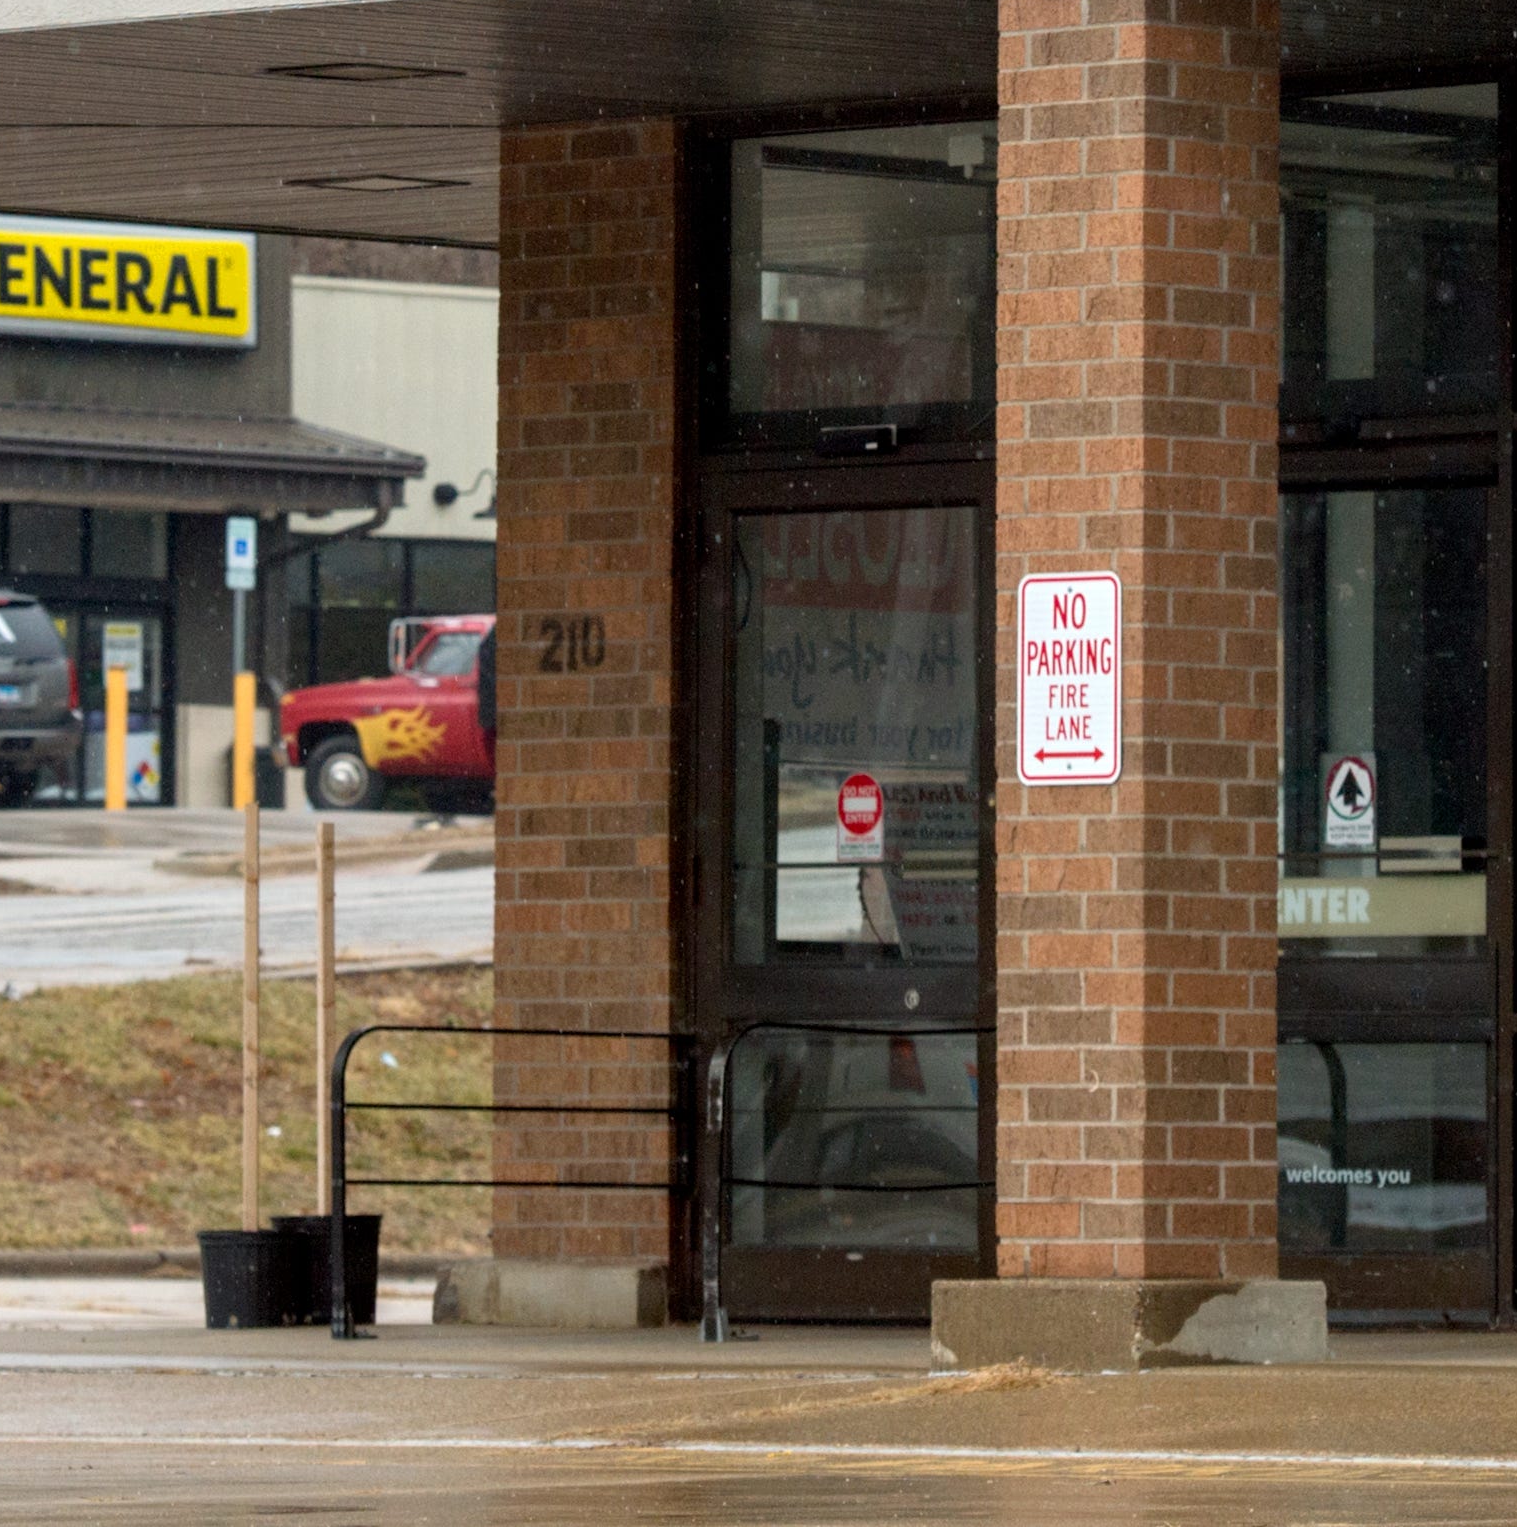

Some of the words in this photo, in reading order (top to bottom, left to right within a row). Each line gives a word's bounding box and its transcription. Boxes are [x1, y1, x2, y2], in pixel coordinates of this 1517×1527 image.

[1053, 593, 1087, 630] NO
[539, 615, 605, 672] 210
[1027, 638, 1112, 676] PARKING
[1049, 683, 1090, 709] FIRE
[1046, 715, 1092, 741] LANE
[843, 785, 856, 797] DO
[859, 785, 878, 798] NOT
[845, 812, 875, 824] ENTER
[1285, 1164, 1373, 1184] welcomes
[1377, 1169, 1412, 1188] you
